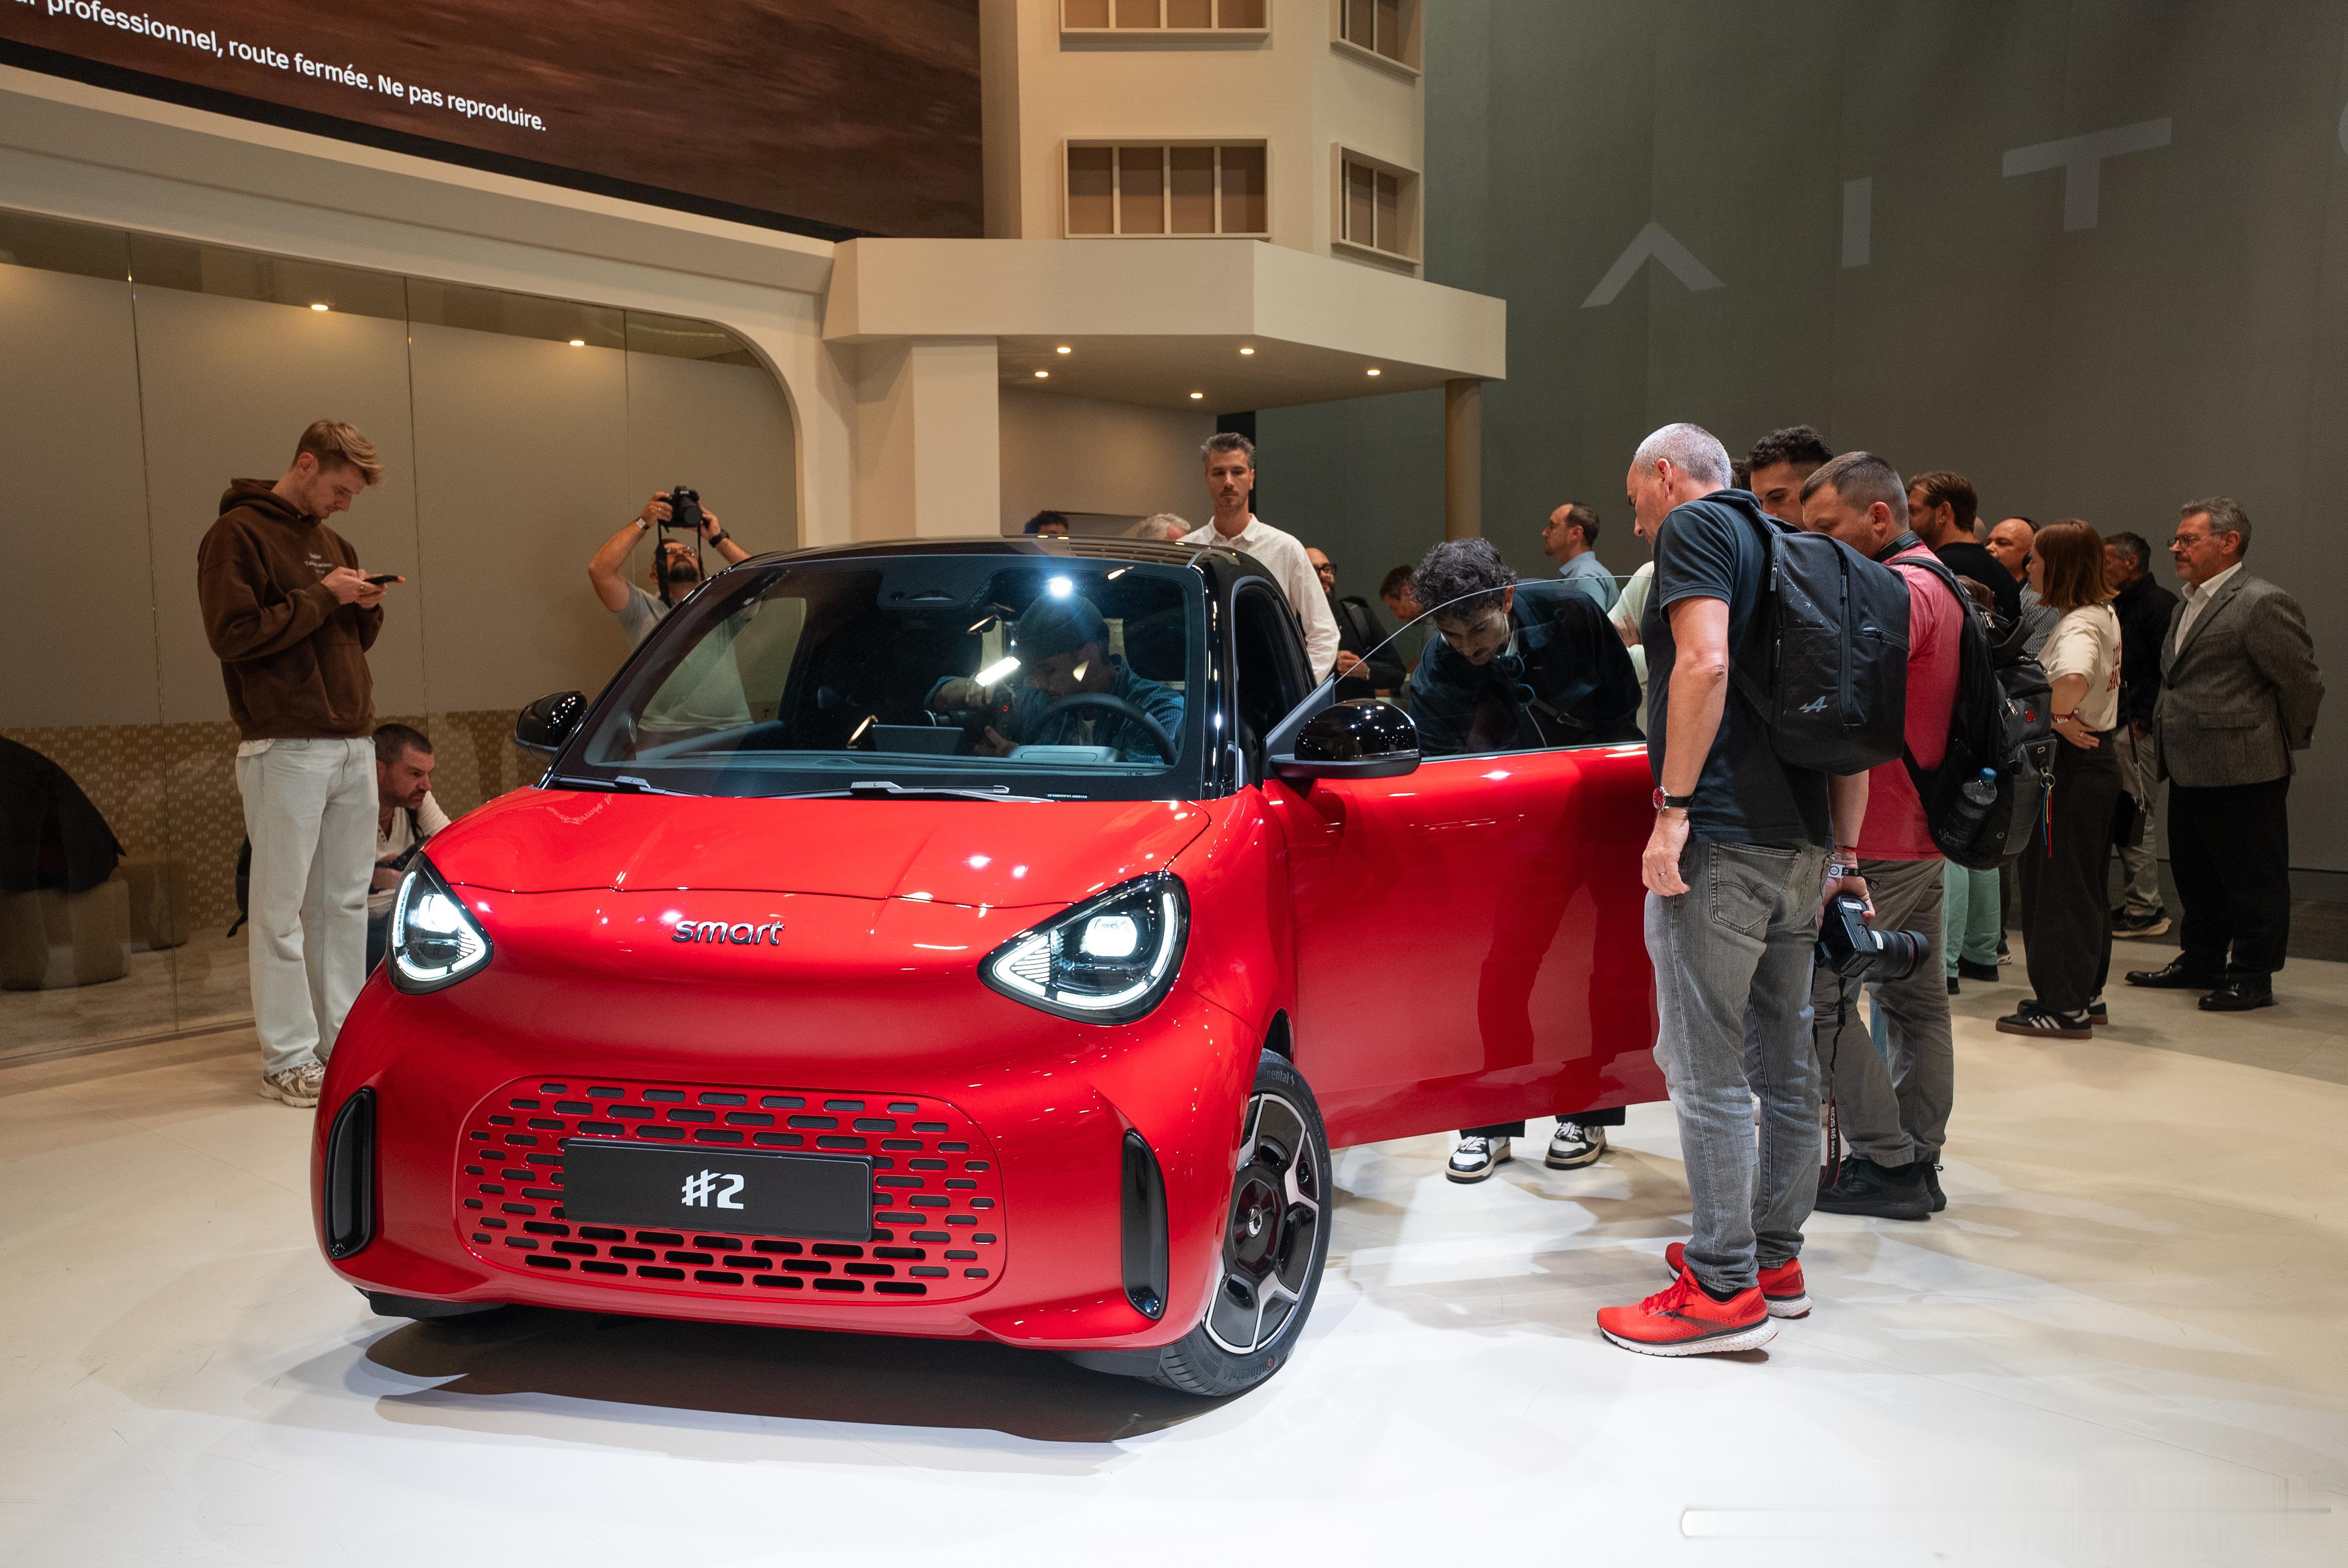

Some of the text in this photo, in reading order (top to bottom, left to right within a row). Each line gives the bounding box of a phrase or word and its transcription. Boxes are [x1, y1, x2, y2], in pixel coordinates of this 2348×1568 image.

[47, 0, 547, 131] professionnel, route fermée. Ne pas reproduire.
[672, 920, 784, 946] smart
[1831, 1128, 1836, 1139] R6
[682, 1169, 744, 1209] #2
